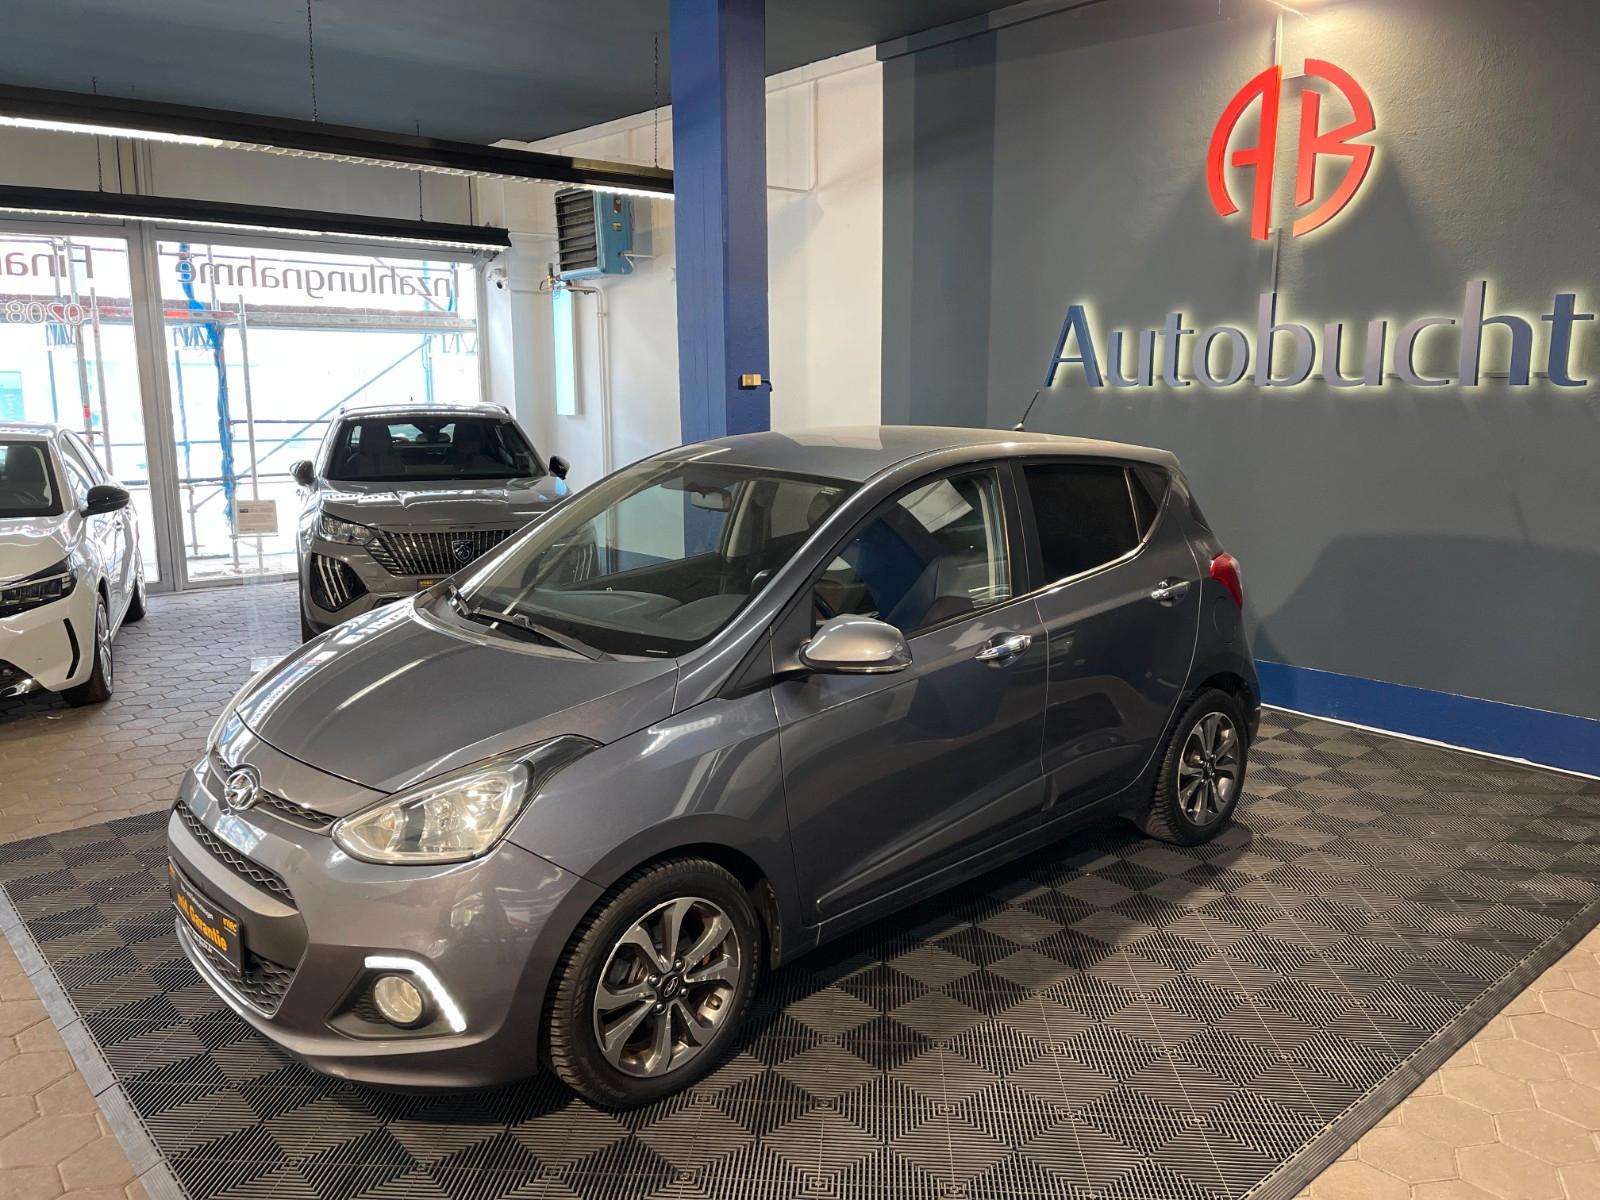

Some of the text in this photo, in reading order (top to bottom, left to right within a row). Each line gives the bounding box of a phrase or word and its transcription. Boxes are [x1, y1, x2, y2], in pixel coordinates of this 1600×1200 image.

[1207, 58, 1376, 241] AB
[1044, 280, 1595, 388] Autobucht
[189, 904, 228, 952] Garantie
